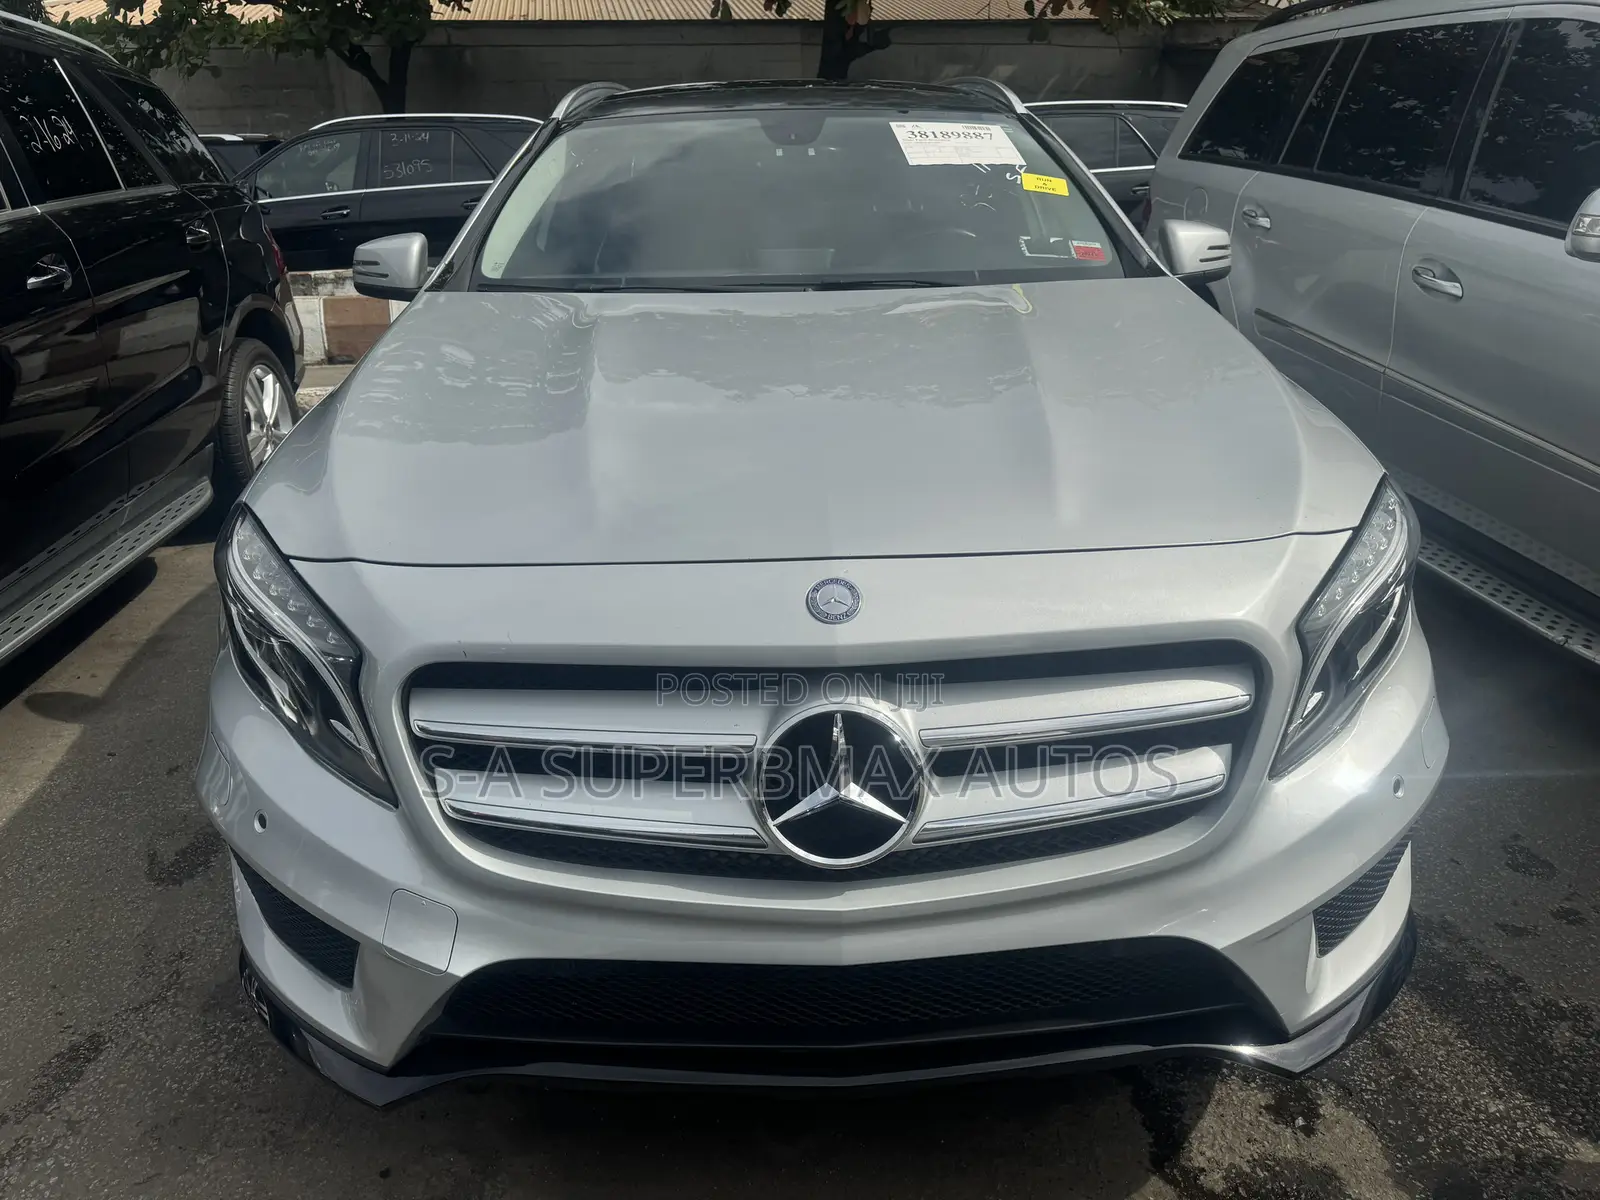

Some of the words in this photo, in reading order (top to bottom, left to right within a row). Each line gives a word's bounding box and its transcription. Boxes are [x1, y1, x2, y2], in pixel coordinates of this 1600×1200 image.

[906, 130, 993, 141] 38189887
[1034, 184, 1057, 192] DRIVE
[827, 613, 847, 621] BENZ
